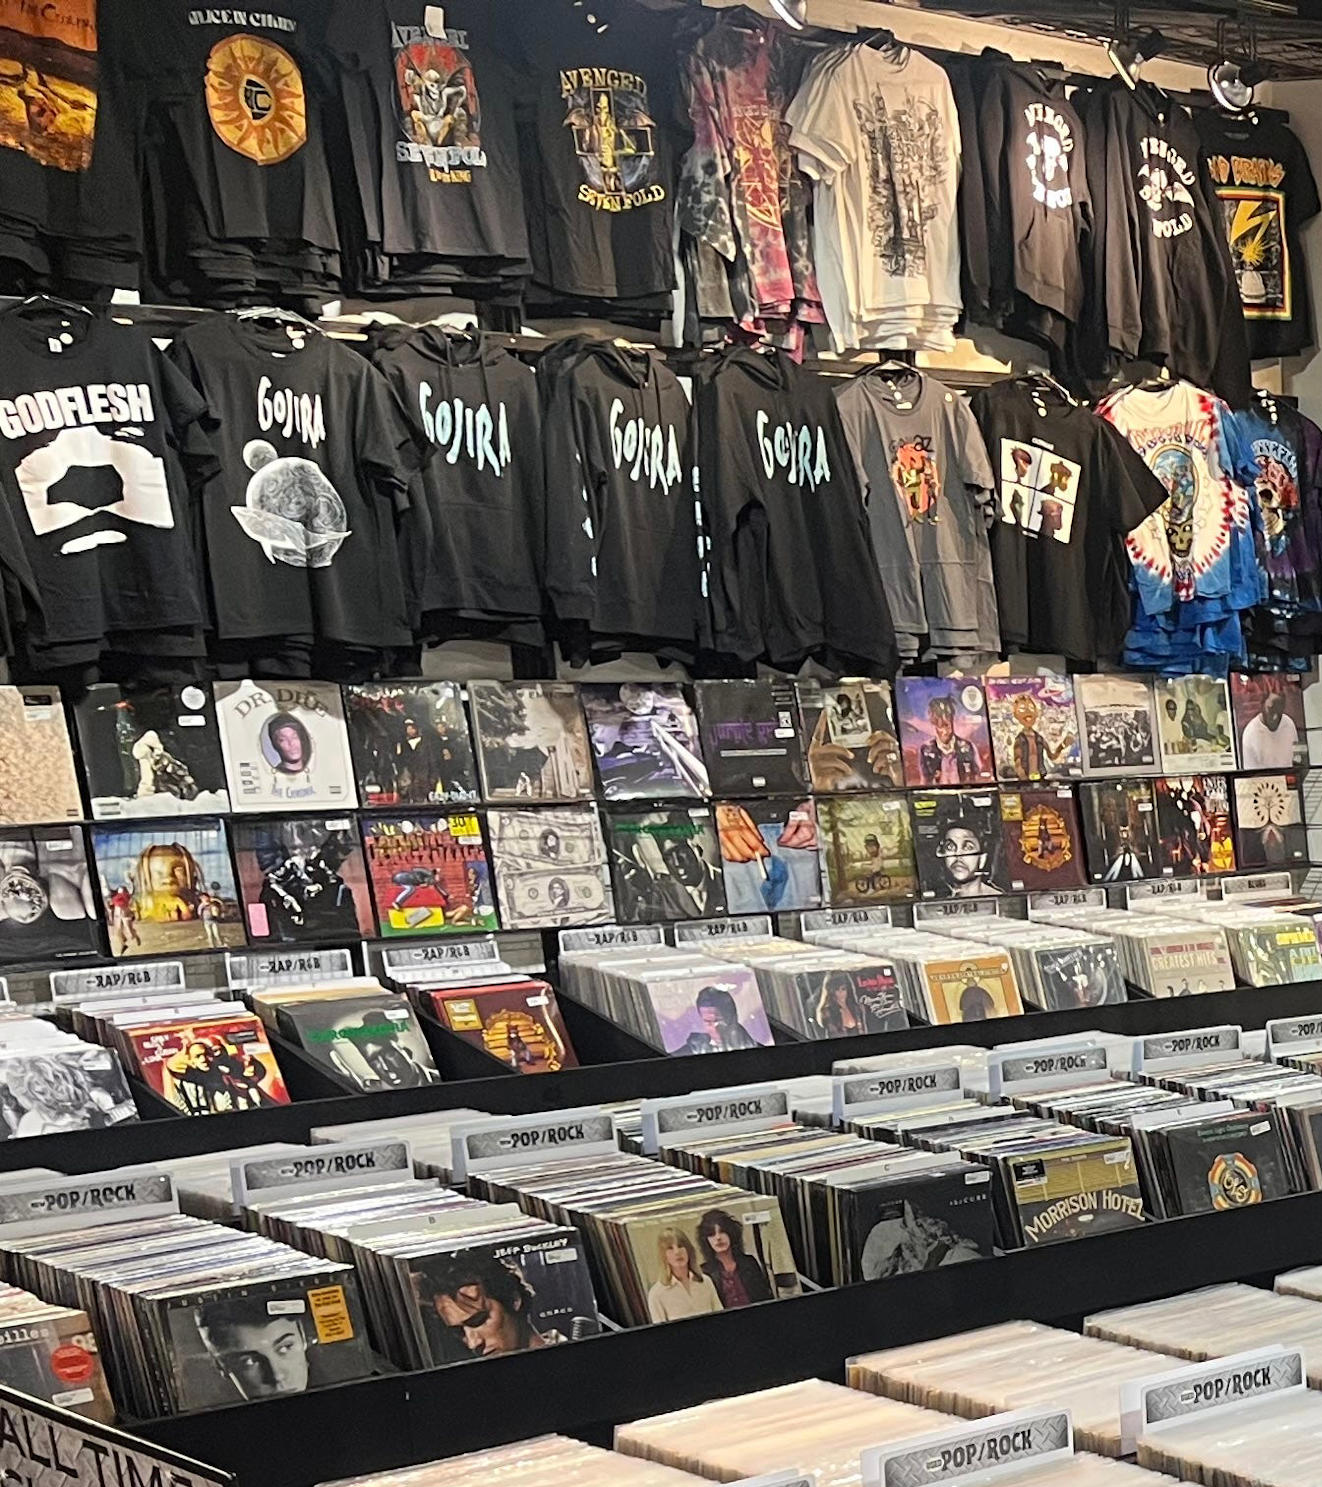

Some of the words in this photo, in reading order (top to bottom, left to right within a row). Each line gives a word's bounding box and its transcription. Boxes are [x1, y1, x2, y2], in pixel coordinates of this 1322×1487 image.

[0, 383, 154, 441] GODFLESH
[258, 375, 326, 449] GOJIRA
[418, 381, 512, 478] GOJIRA
[609, 400, 682, 496] GOJIRA
[1173, 1035, 1219, 1053] POP/ROCK
[879, 1072, 937, 1096] POP/ROCK
[1034, 1055, 1086, 1074] POP/ROCK
[697, 1099, 762, 1125] POP/ROCK
[511, 1124, 585, 1150] POP/ROCK
[294, 1151, 376, 1178] POP/ROCK
[46, 1183, 136, 1211] POP/ROCK
[1024, 1191, 1100, 1243] MORRISON
[1102, 1189, 1147, 1222] HOTEL
[1193, 1365, 1271, 1404] POP/ROCK
[0, 1407, 79, 1478] ALL
[941, 1429, 1033, 1472] POP/ROCK
